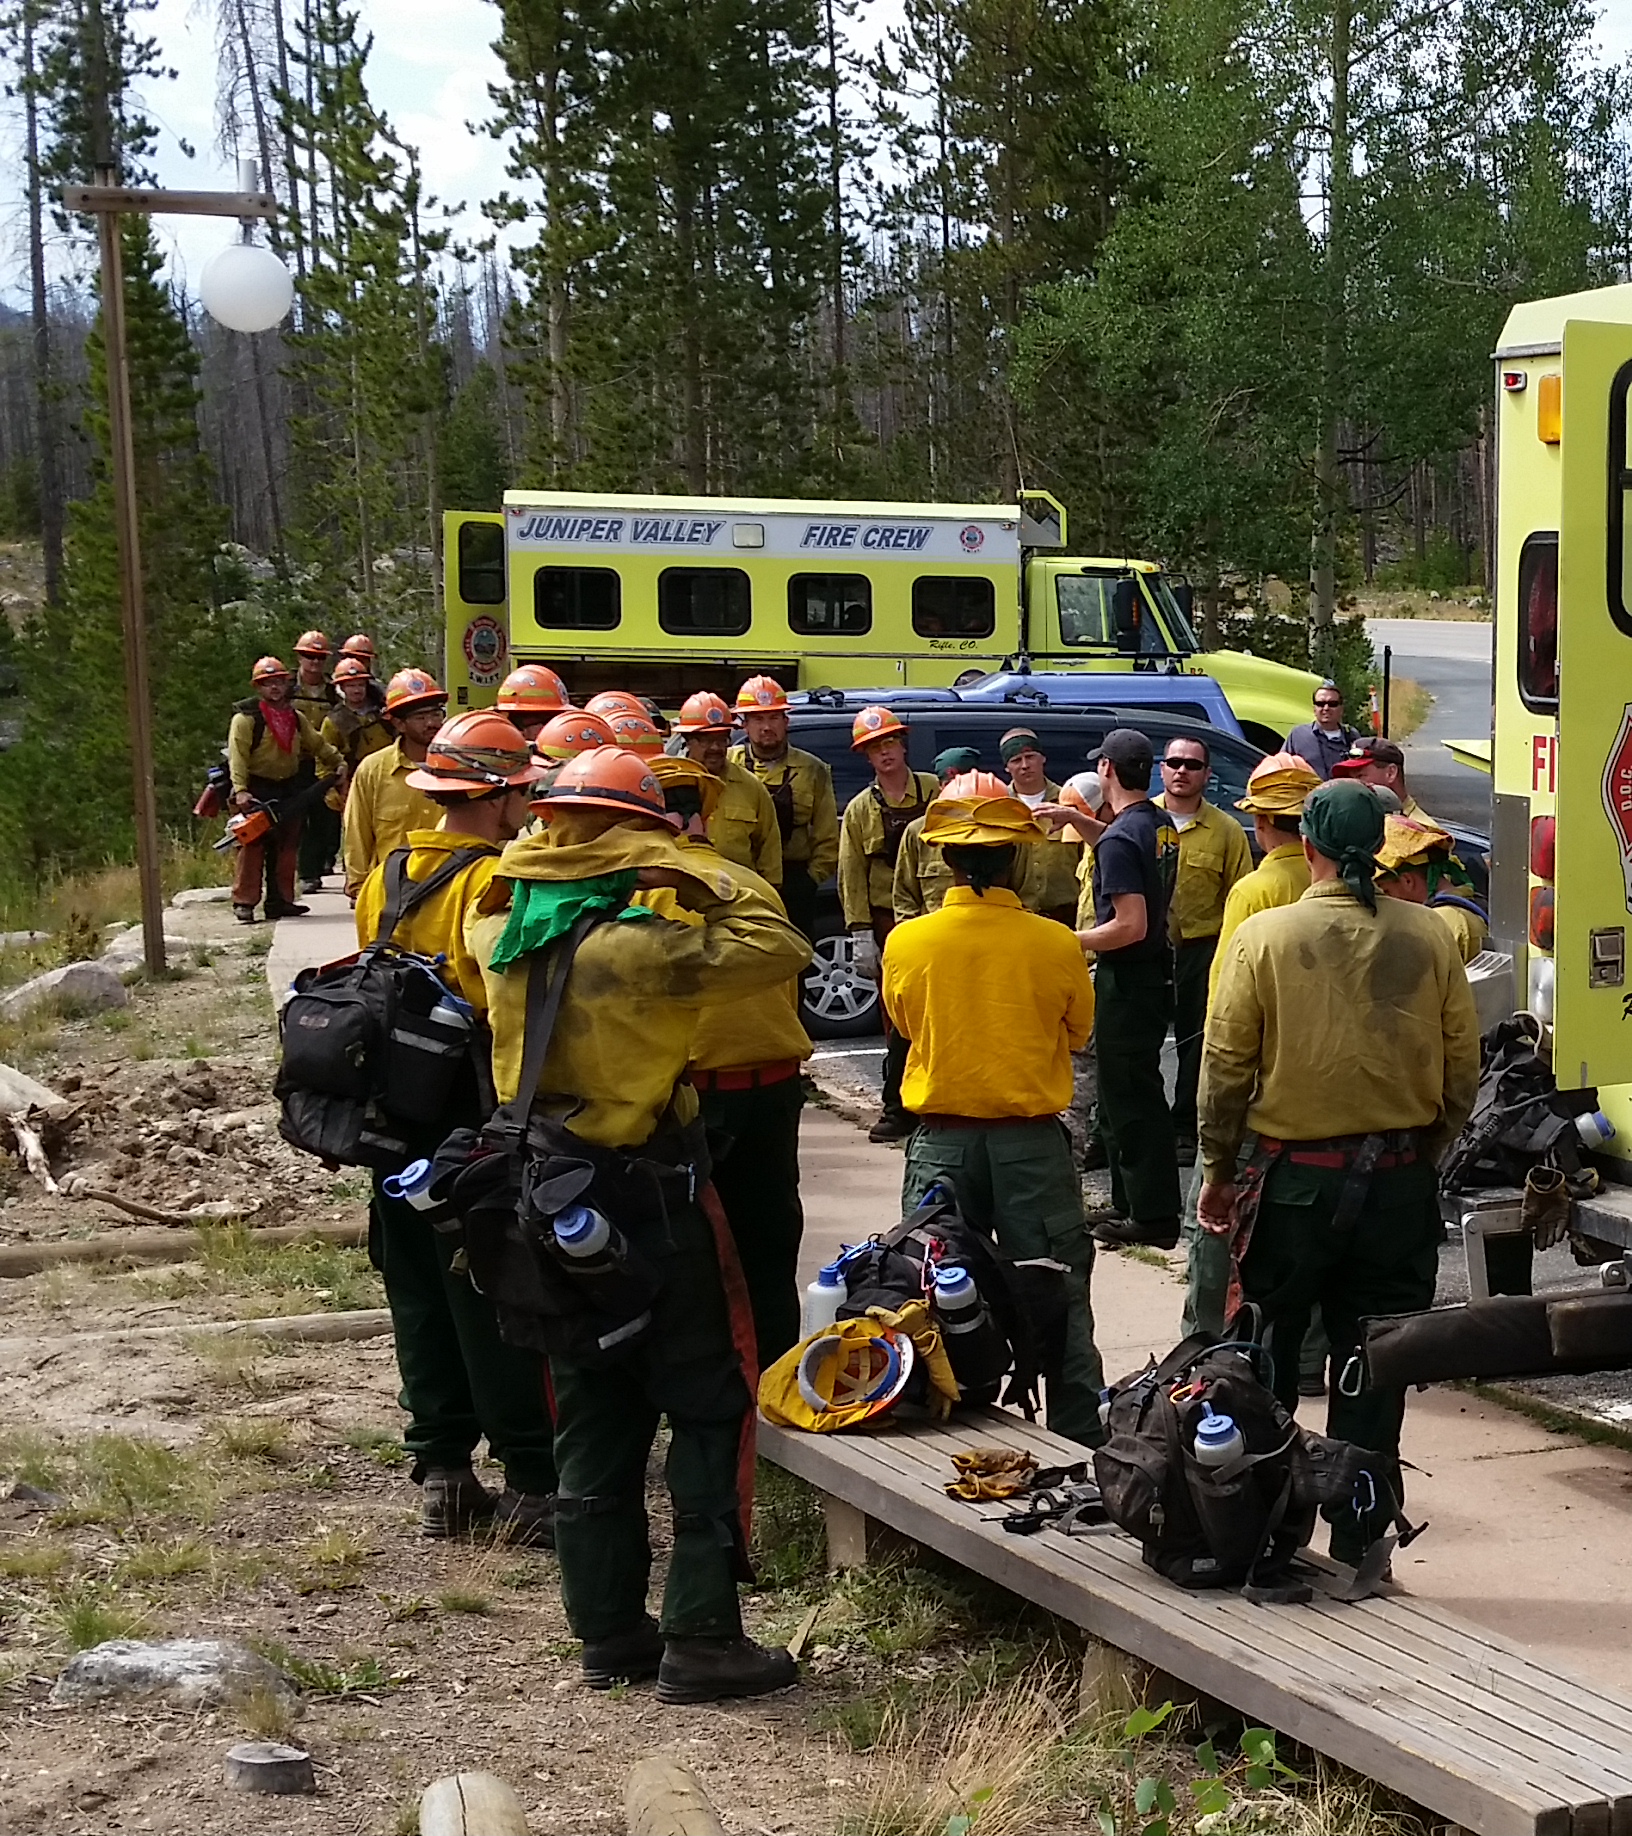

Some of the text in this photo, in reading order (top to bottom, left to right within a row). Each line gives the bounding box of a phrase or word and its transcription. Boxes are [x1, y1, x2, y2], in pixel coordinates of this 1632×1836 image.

[518, 517, 726, 545] JUNIPER VALLEY
[800, 523, 934, 550] FIRE CREW
